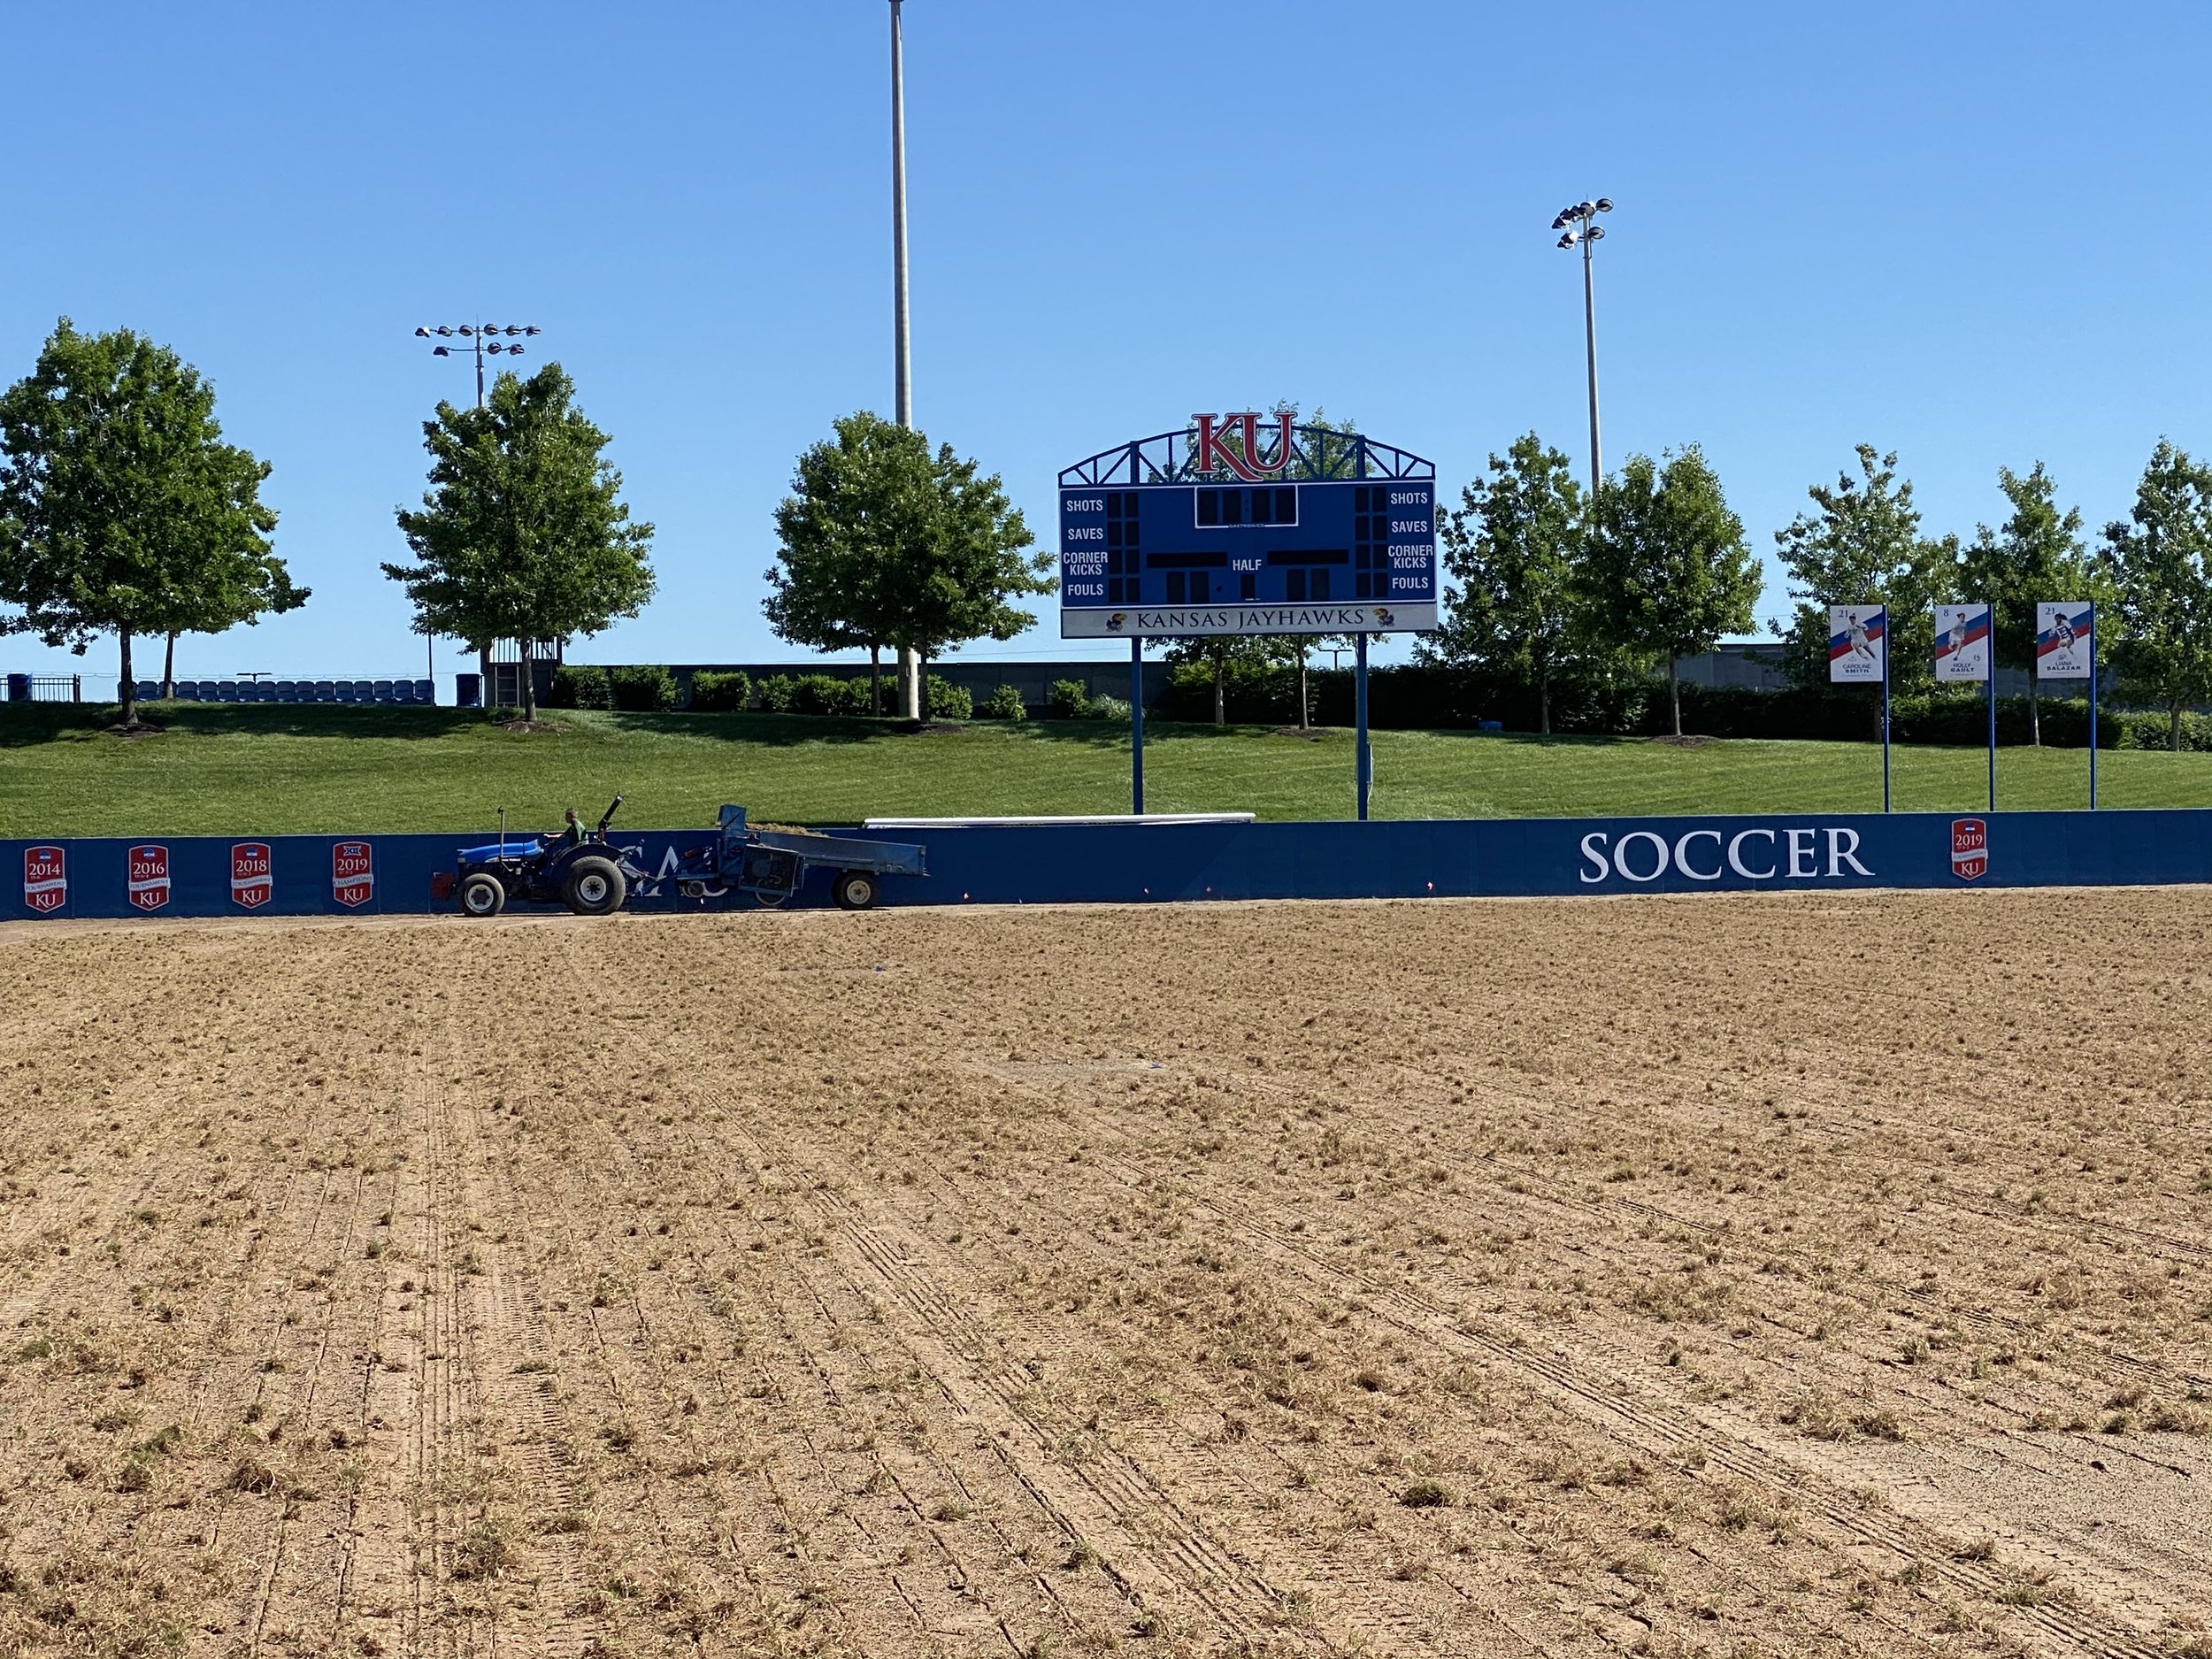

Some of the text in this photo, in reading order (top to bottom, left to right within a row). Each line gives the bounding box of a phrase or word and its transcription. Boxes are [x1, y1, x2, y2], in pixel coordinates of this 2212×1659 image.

[1191, 411, 1298, 482] KU
[1390, 492, 1428, 504] SHOTS
[1066, 499, 1103, 511] SHOTS
[1391, 520, 1428, 533] SAVES
[1067, 527, 1103, 540] SAVES
[1387, 544, 1433, 557] CORNER
[1063, 551, 1108, 565] CORNER
[1233, 558, 1262, 571] HALF
[1394, 557, 1427, 569] KICKS
[1070, 564, 1102, 575] KICKS
[1067, 583, 1103, 595] FOULS
[1392, 577, 1429, 589] FOULS
[1137, 609, 1364, 630] KANSAS JAYHAWKS
[1839, 609, 1848, 618] 21
[1955, 833, 1983, 846] 2019
[1580, 827, 1876, 883] SOCCER
[28, 863, 60, 876] 2014
[133, 862, 165, 874] 2016
[235, 859, 267, 872] 2018
[337, 858, 368, 871] 2019
[1962, 863, 1979, 876] KU
[35, 894, 57, 908] KU
[139, 892, 160, 906] KU
[242, 889, 262, 903] KU
[343, 888, 364, 902] KU
